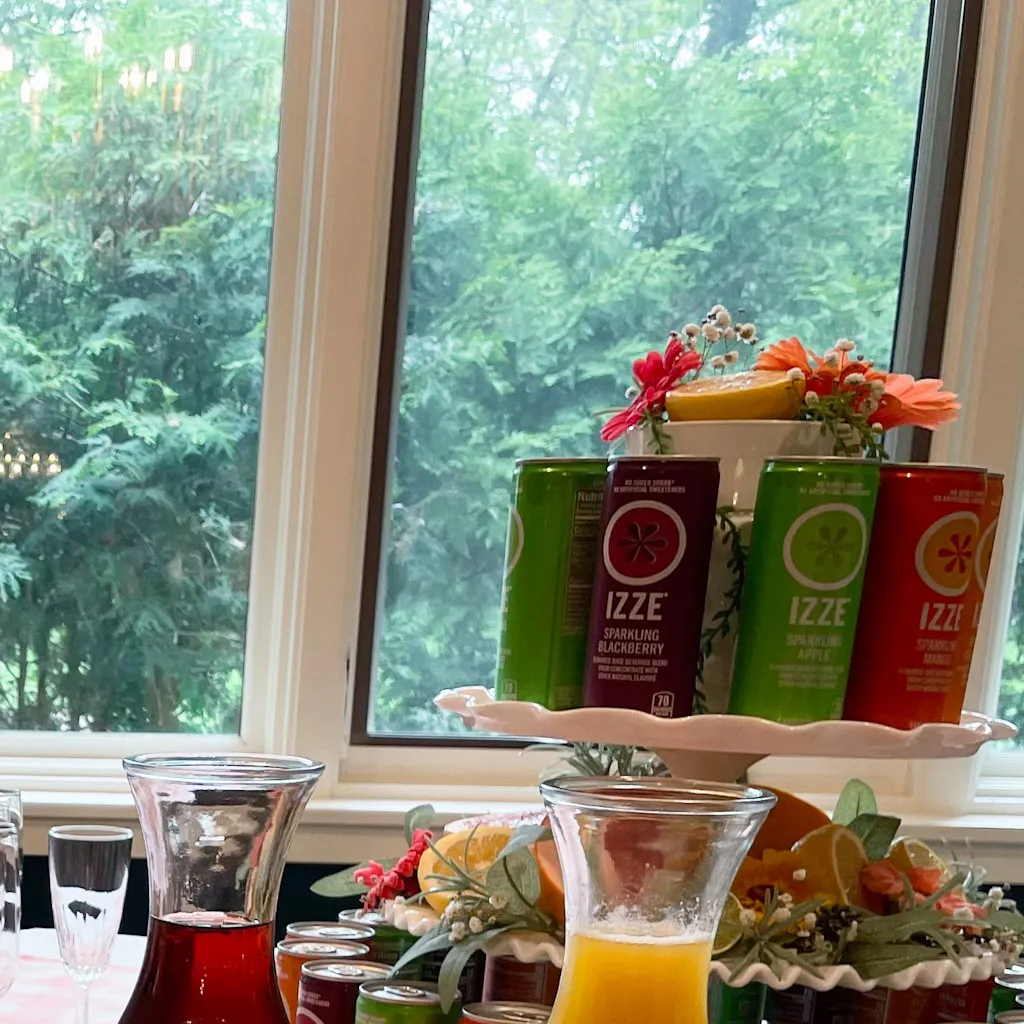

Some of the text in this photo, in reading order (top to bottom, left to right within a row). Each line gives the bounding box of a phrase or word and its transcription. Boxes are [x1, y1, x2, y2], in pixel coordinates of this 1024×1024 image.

[605, 591, 666, 621] IZZE
[789, 596, 850, 627] IZZE
[603, 627, 660, 641] SPARKLING
[598, 640, 665, 655] BLACKBERRY
[658, 695, 670, 707] 70
